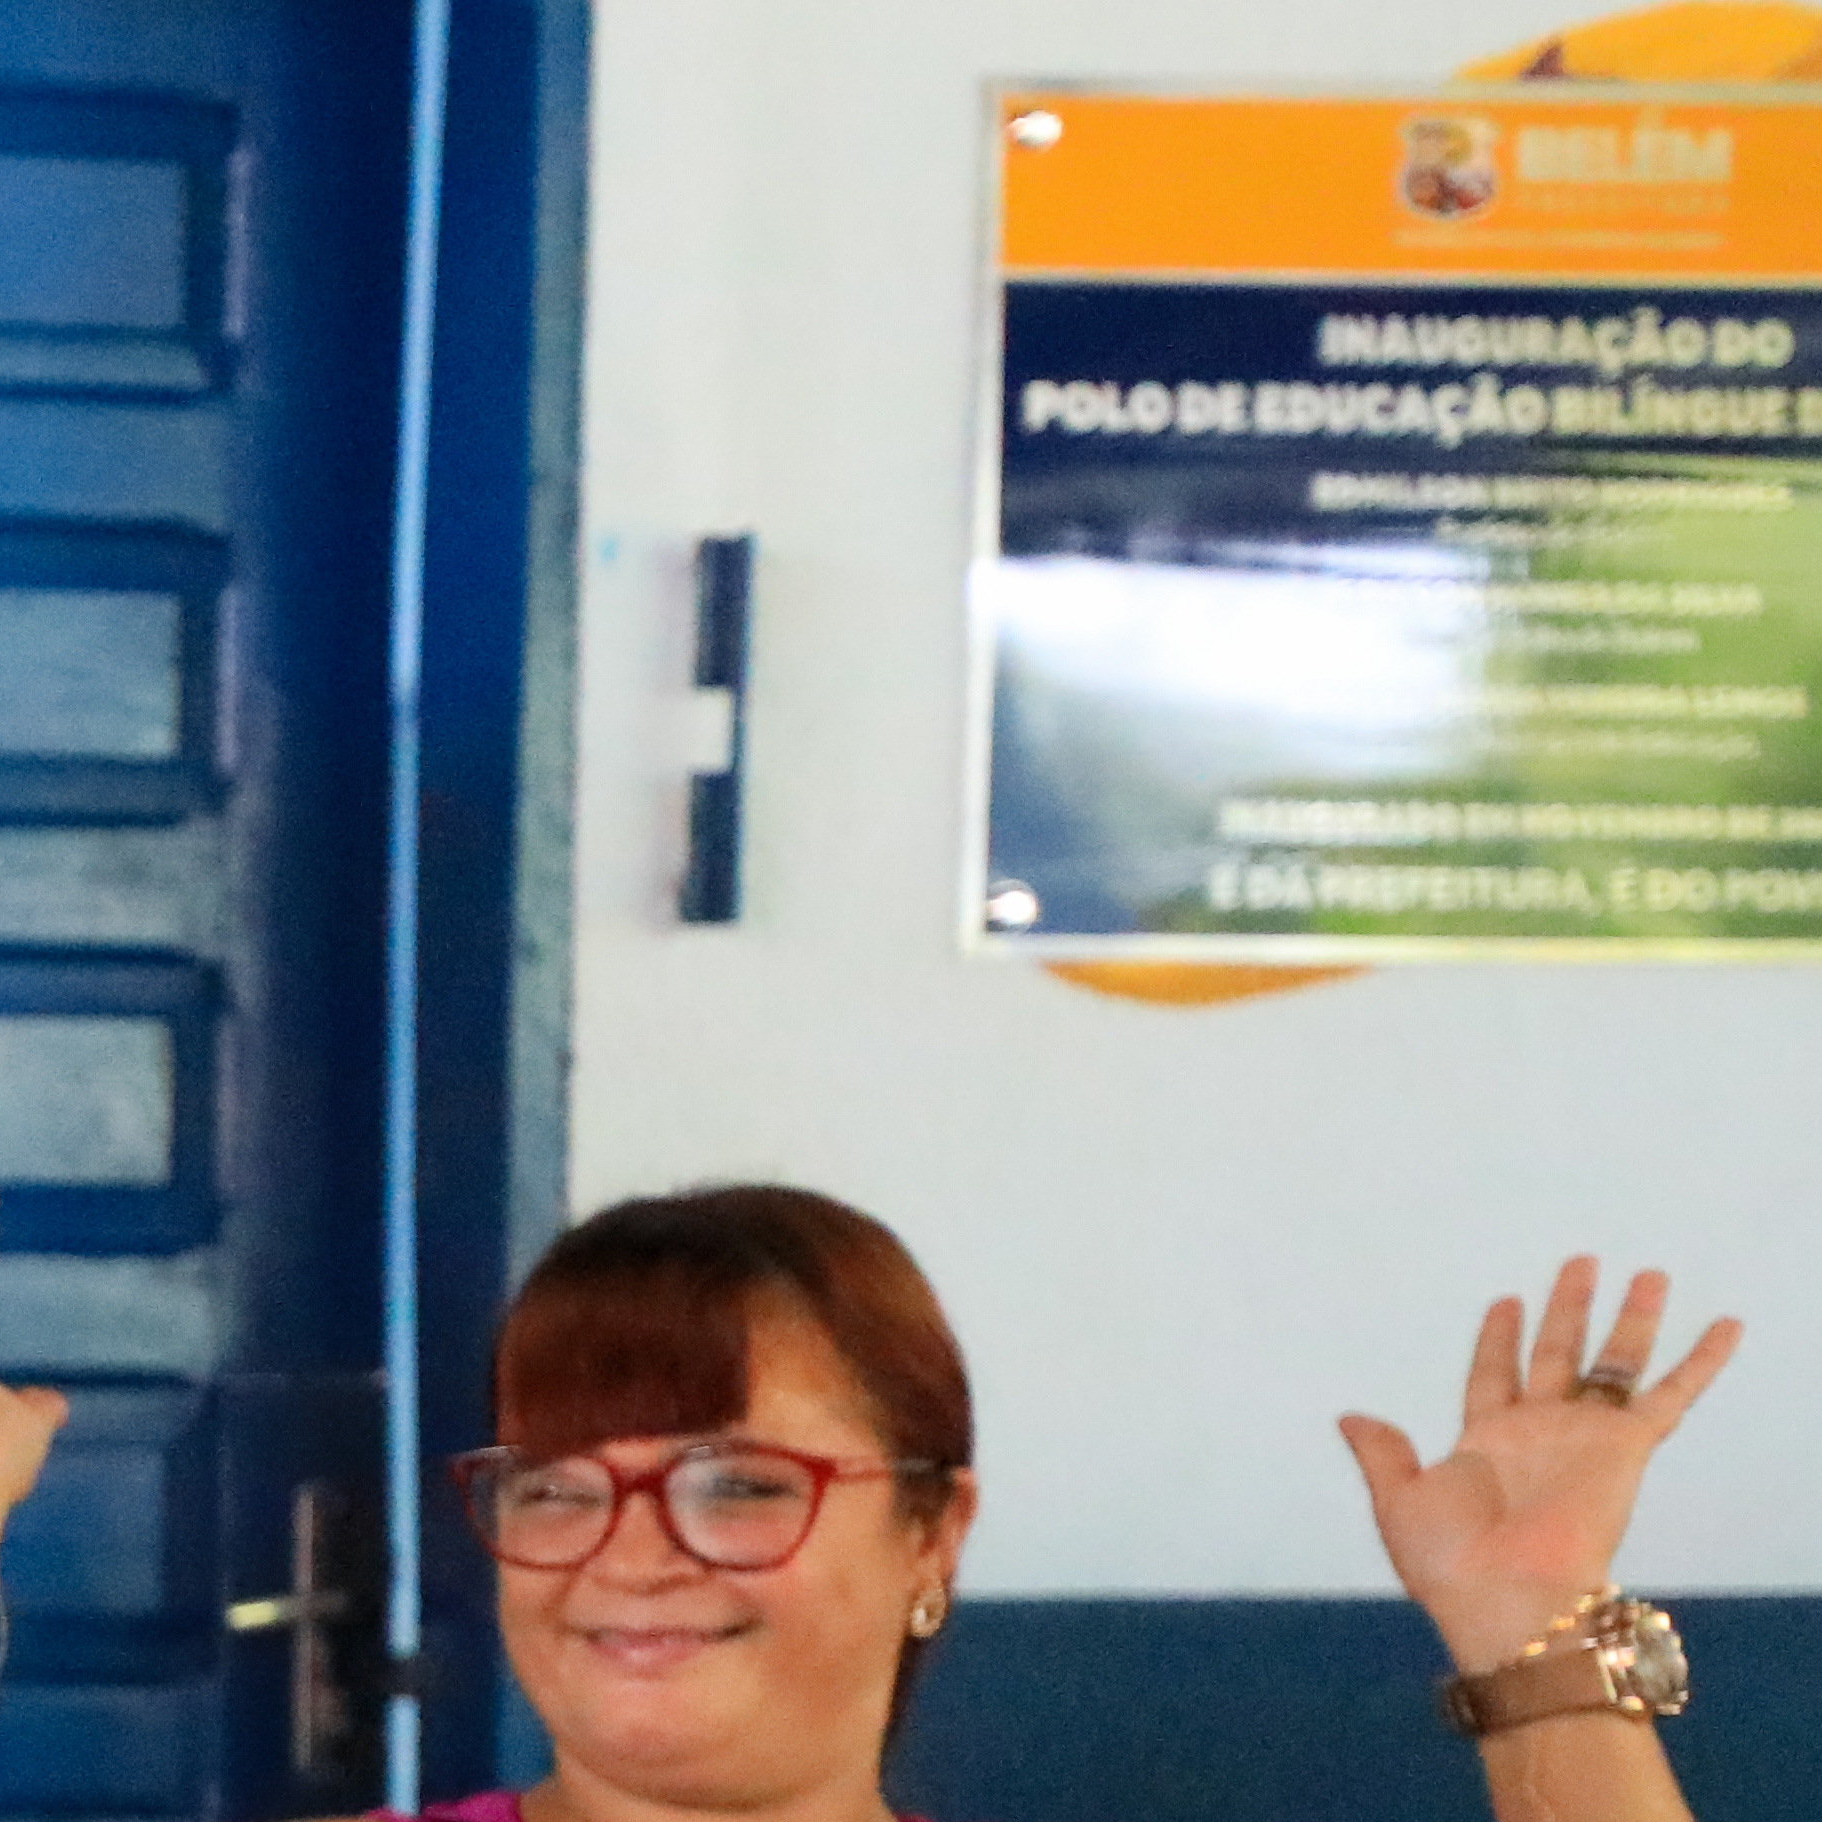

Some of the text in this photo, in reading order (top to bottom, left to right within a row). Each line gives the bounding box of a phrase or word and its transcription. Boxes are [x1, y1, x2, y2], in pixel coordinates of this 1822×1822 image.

[1318, 307, 1795, 375] INAUGURAÇÃO DO
[1022, 379, 1171, 434] POLO
[1176, 380, 1246, 435] DE
[1253, 372, 1546, 448] EDUCAÇÃO
[1551, 374, 1790, 437] BILÍNGUE
[1644, 866, 1719, 913] DO
